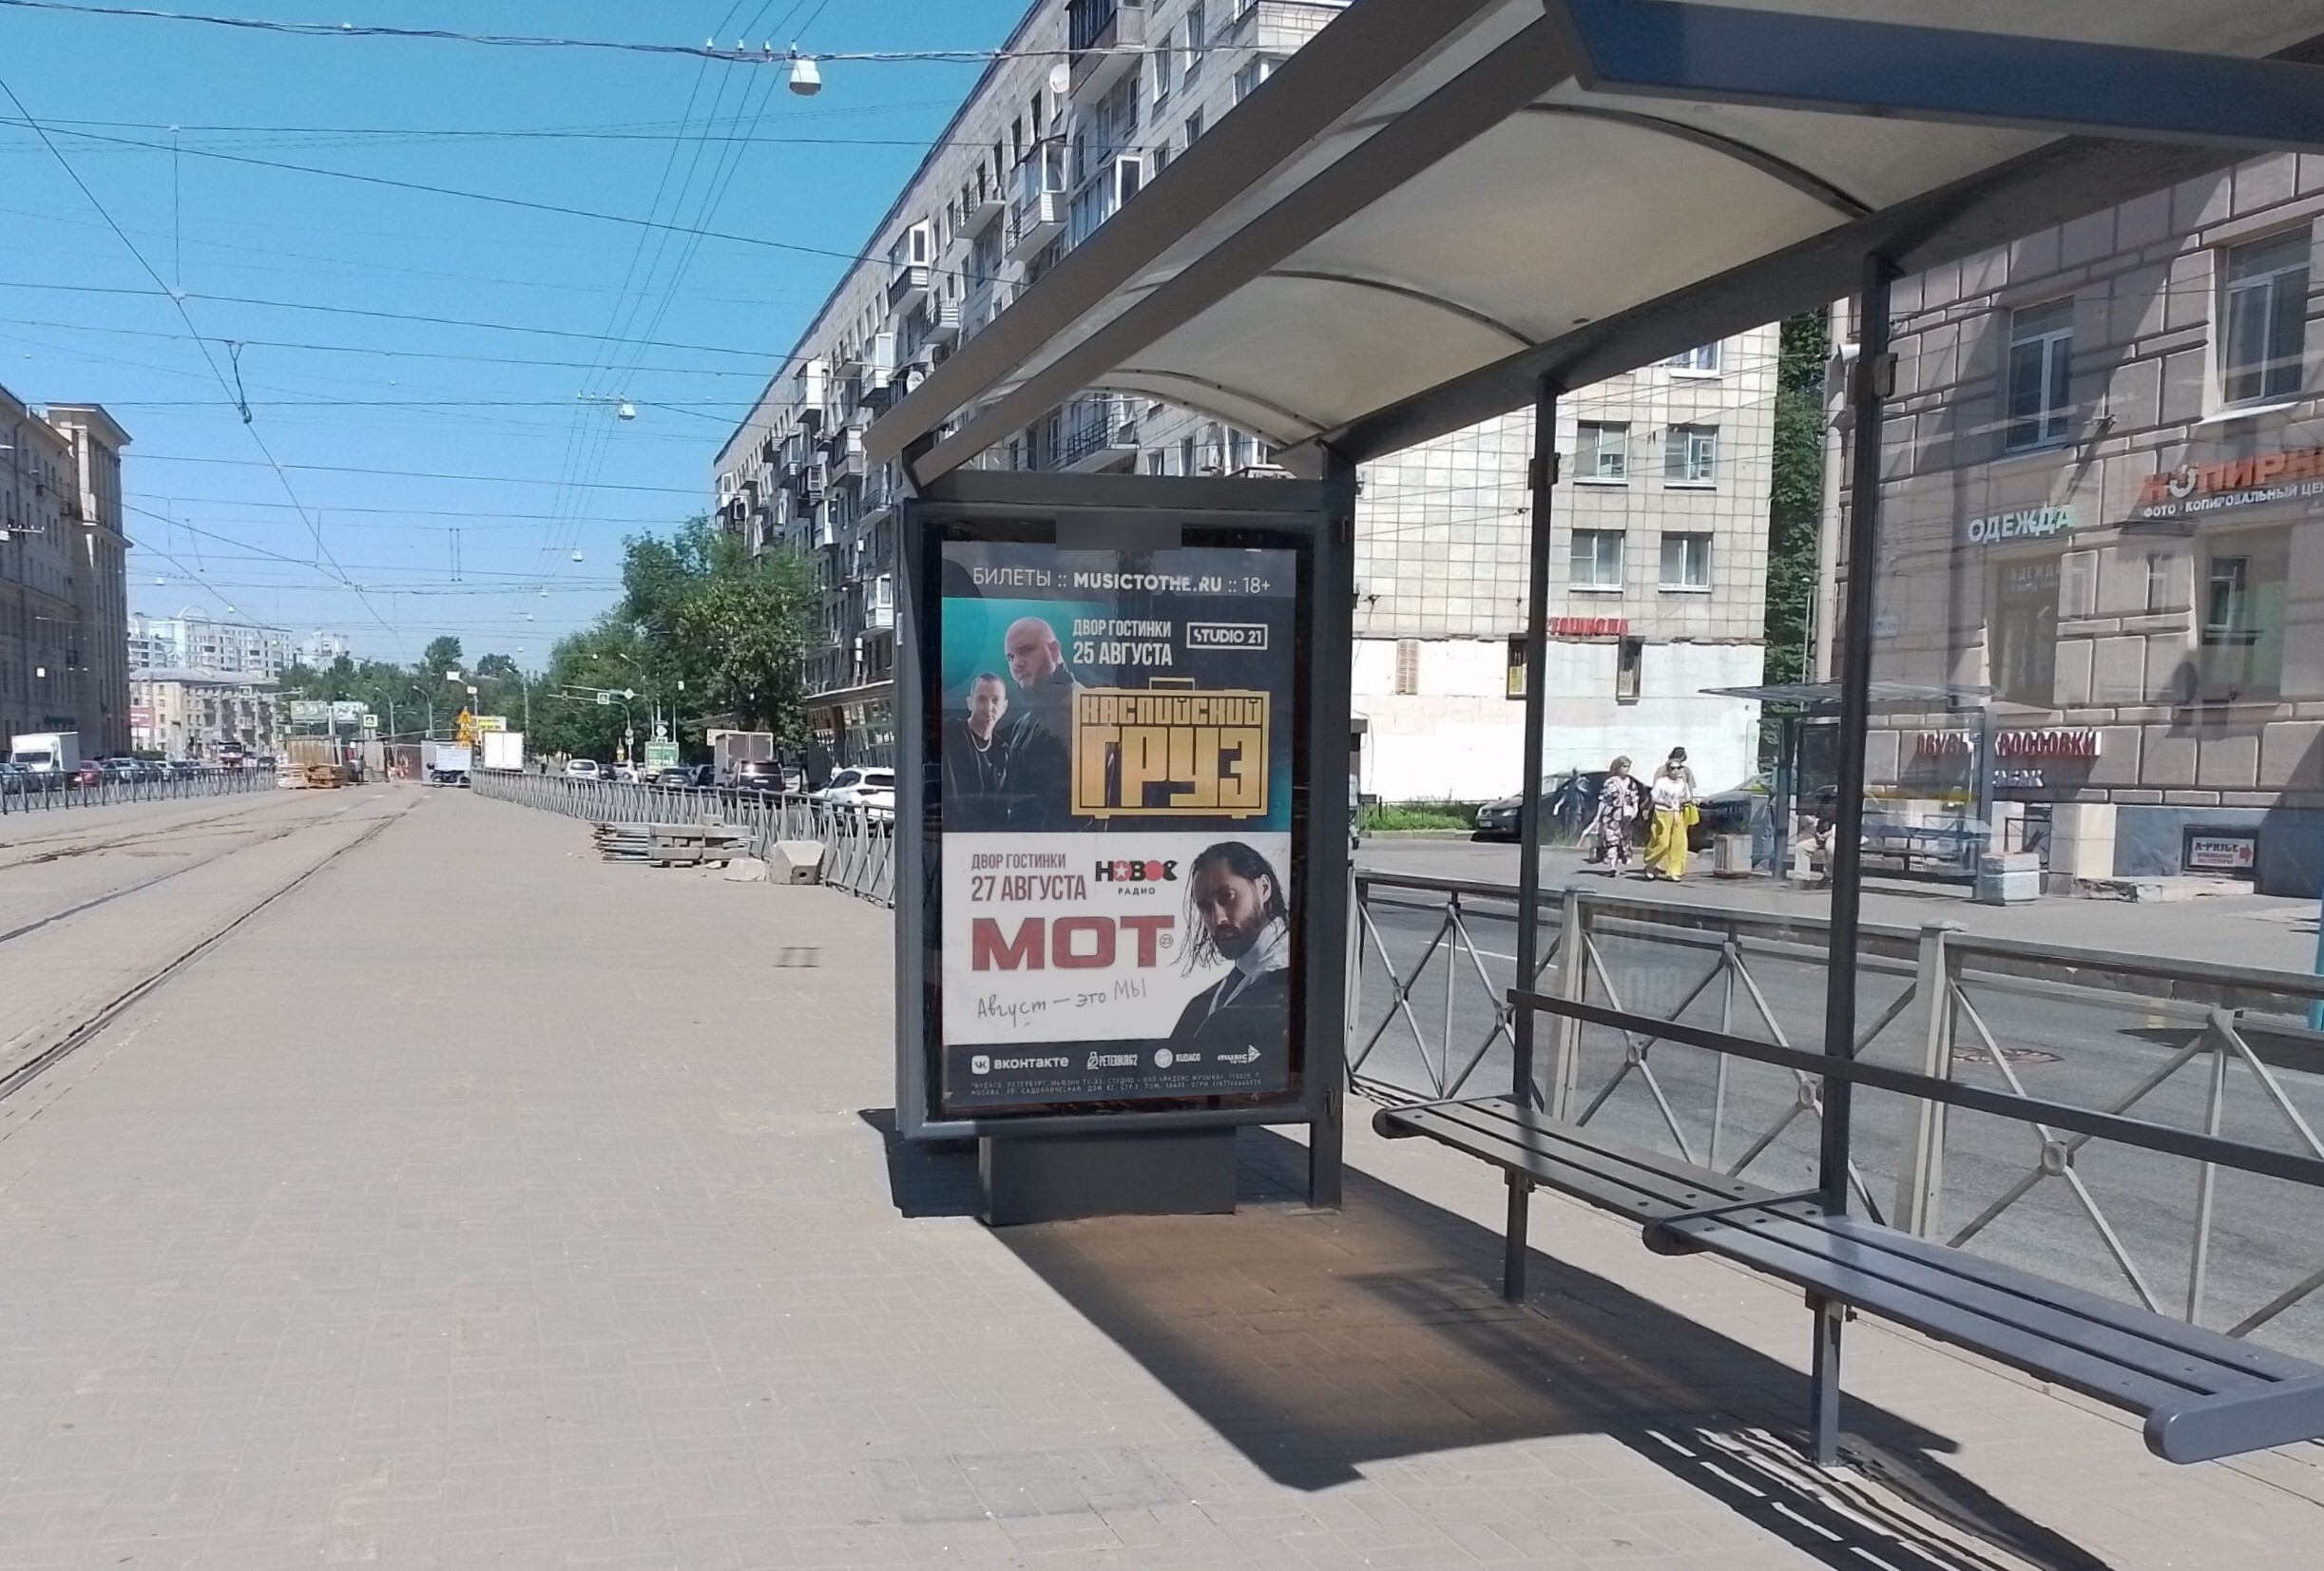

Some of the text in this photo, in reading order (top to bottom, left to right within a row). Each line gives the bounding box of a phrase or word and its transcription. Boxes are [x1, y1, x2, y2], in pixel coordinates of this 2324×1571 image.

[2143, 504, 2176, 518] ФОТО
[1968, 505, 2077, 544] ОДЕЖДА
[972, 567, 1051, 586] БИЛЕТЫ
[1074, 573, 1222, 592] MUSICTOTHE.RU
[1243, 577, 1271, 593] 18+
[1072, 619, 1171, 638] ДВОР ГОСТИНКИ
[1193, 628, 1262, 643] STUDIO 21
[1072, 641, 1173, 666] 25 АВГУСТА
[1081, 696, 1261, 725] КАСПИЙСКИЙ
[1081, 726, 1261, 807] ГРУЗ
[971, 853, 1066, 871] ДВОР ГОСТИНКИ
[970, 874, 1086, 902] 27 АВГУСТА
[1118, 888, 1156, 896] РАДИО
[971, 915, 1175, 971] МОТ
[977, 994, 1047, 1026] Август
[1075, 993, 1106, 1007] это
[1114, 979, 1146, 1001] МЫ
[993, 1057, 1069, 1070] вконтакте
